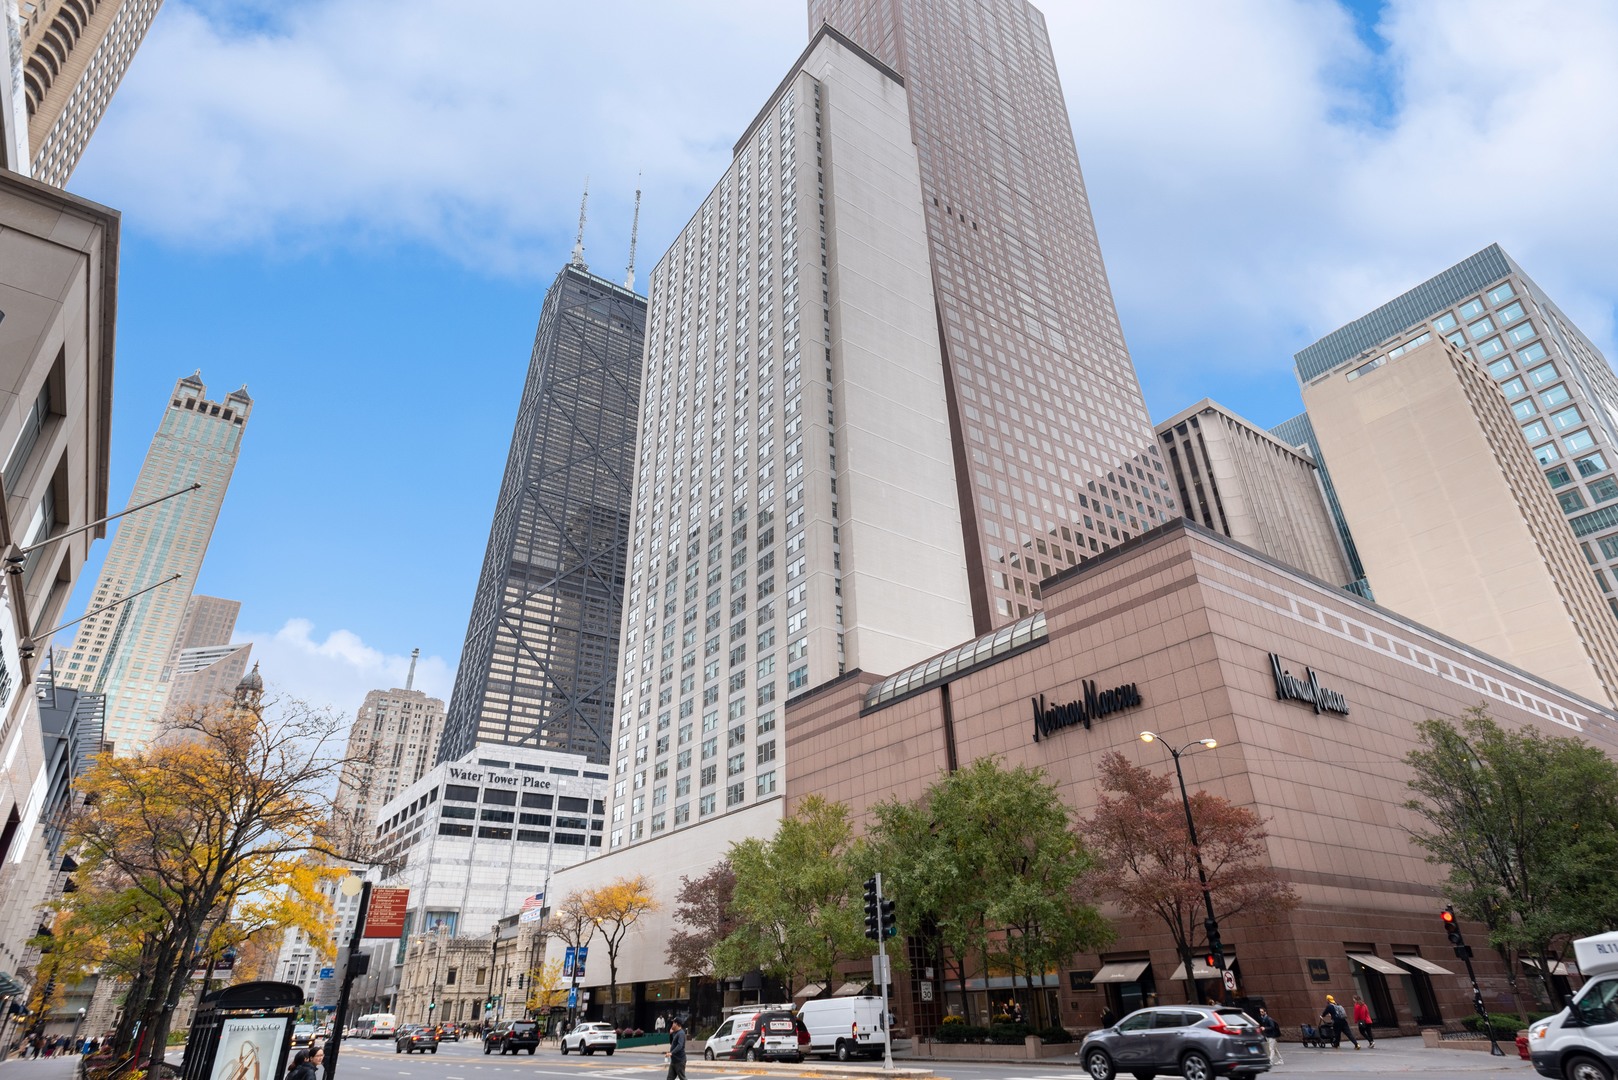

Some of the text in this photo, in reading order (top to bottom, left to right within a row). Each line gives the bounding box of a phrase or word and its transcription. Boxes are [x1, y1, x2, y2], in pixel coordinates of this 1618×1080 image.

[1268, 651, 1349, 715] Neiman Marcus
[1031, 679, 1143, 742] Neiman Marcus
[450, 768, 551, 788] Water Tower Place
[923, 991, 932, 999] 30
[228, 1024, 260, 1032] TIFFANY
